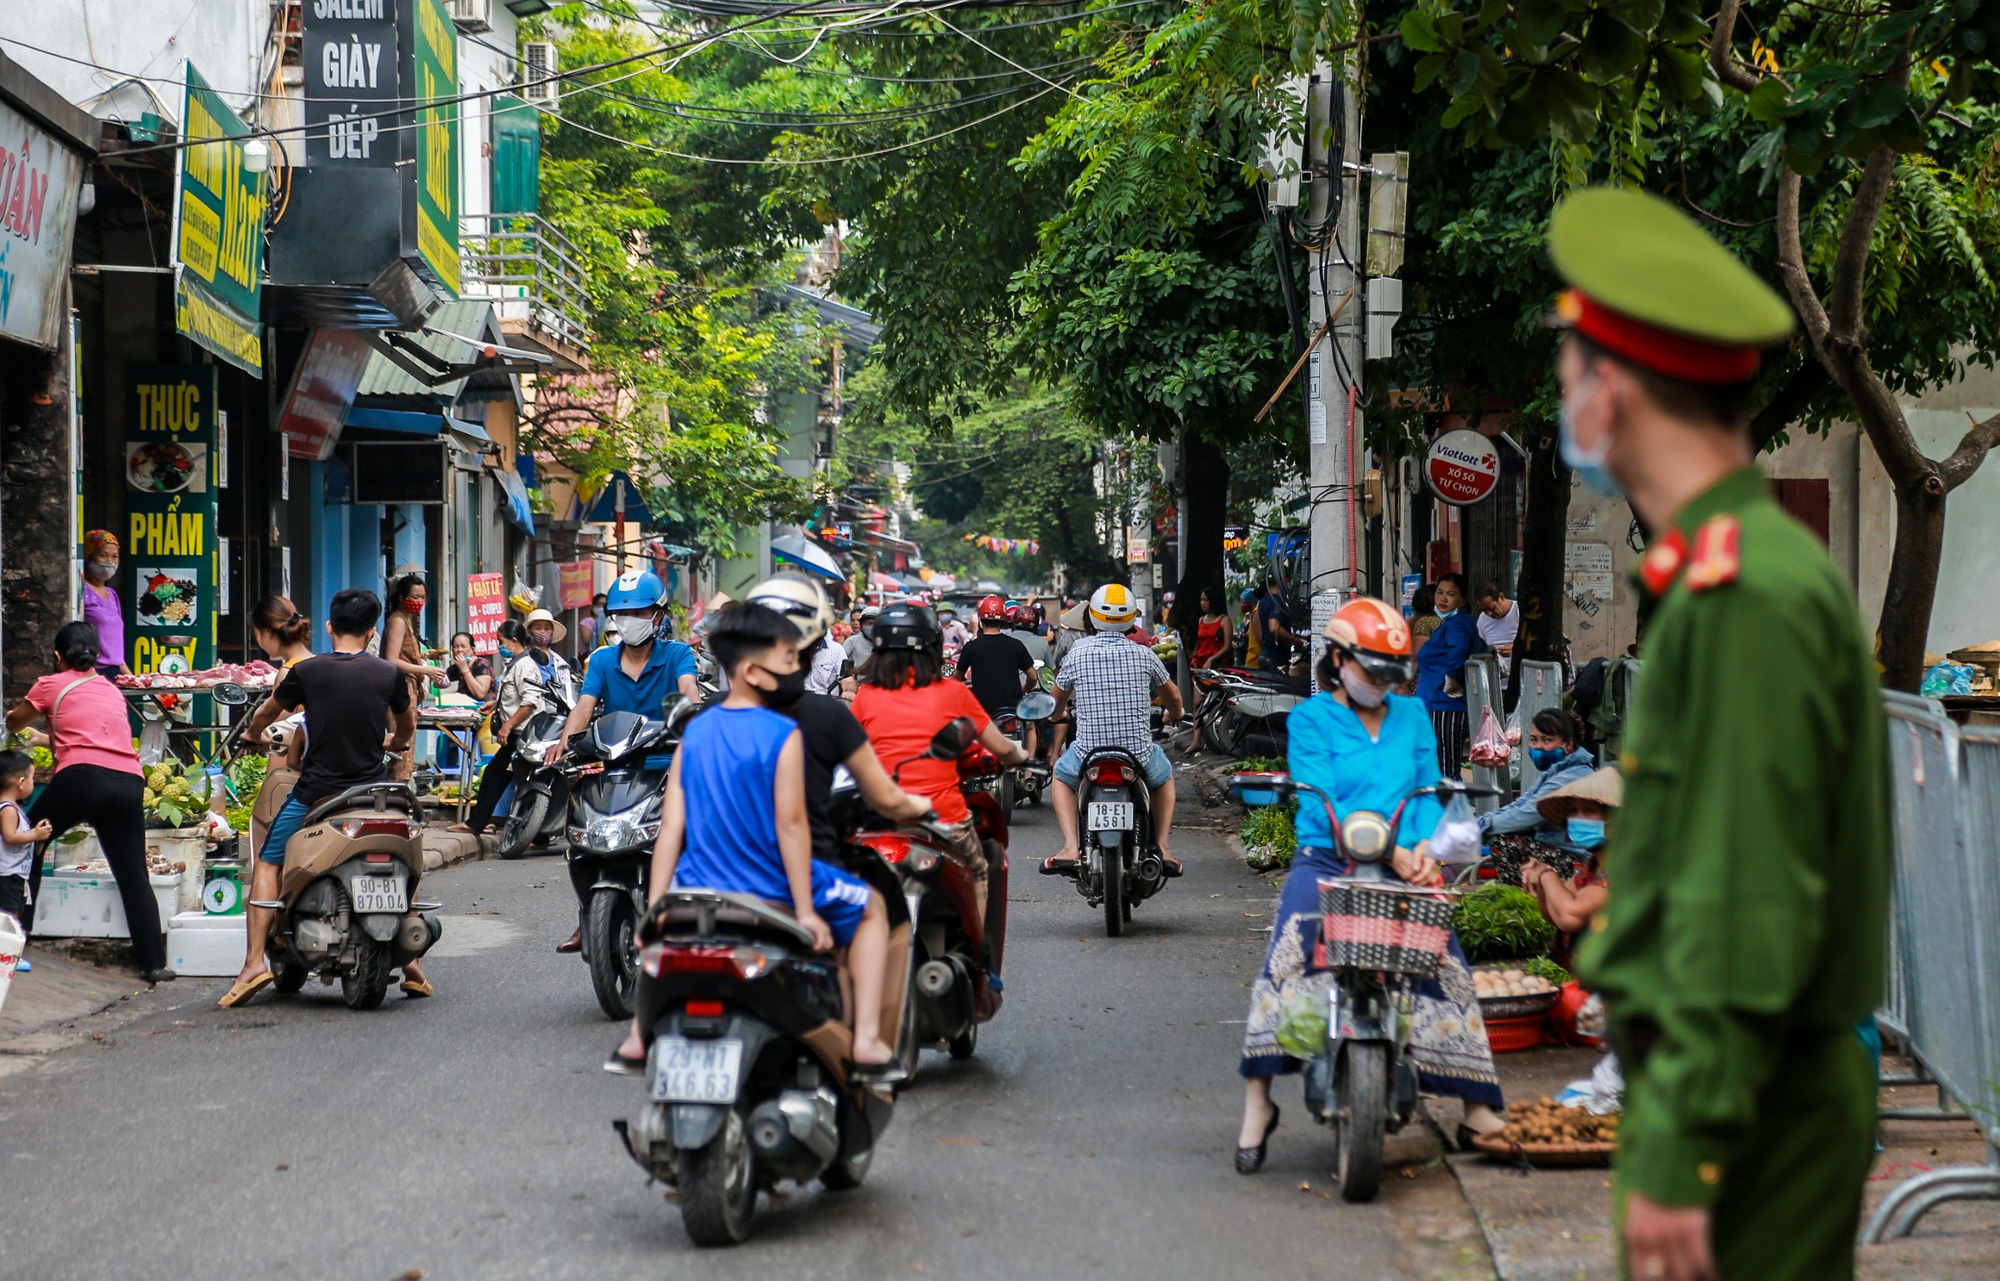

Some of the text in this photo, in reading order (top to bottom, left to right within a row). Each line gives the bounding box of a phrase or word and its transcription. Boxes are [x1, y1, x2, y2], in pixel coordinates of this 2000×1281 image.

[322, 34, 381, 88] GIÀY
[328, 104, 379, 159] DÉP
[136, 380, 200, 442] THỰC
[1437, 445, 1479, 466] Vietlott
[1439, 477, 1479, 496] TỰ CHỌN
[1462, 472, 1475, 482] SỐ
[130, 495, 204, 556] PHẨM
[134, 636, 198, 675] CHY
[1096, 804, 1126, 816] 18-E1
[1095, 816, 1126, 828] 4581
[360, 878, 397, 893] 90-B1
[357, 894, 404, 910] 870.04
